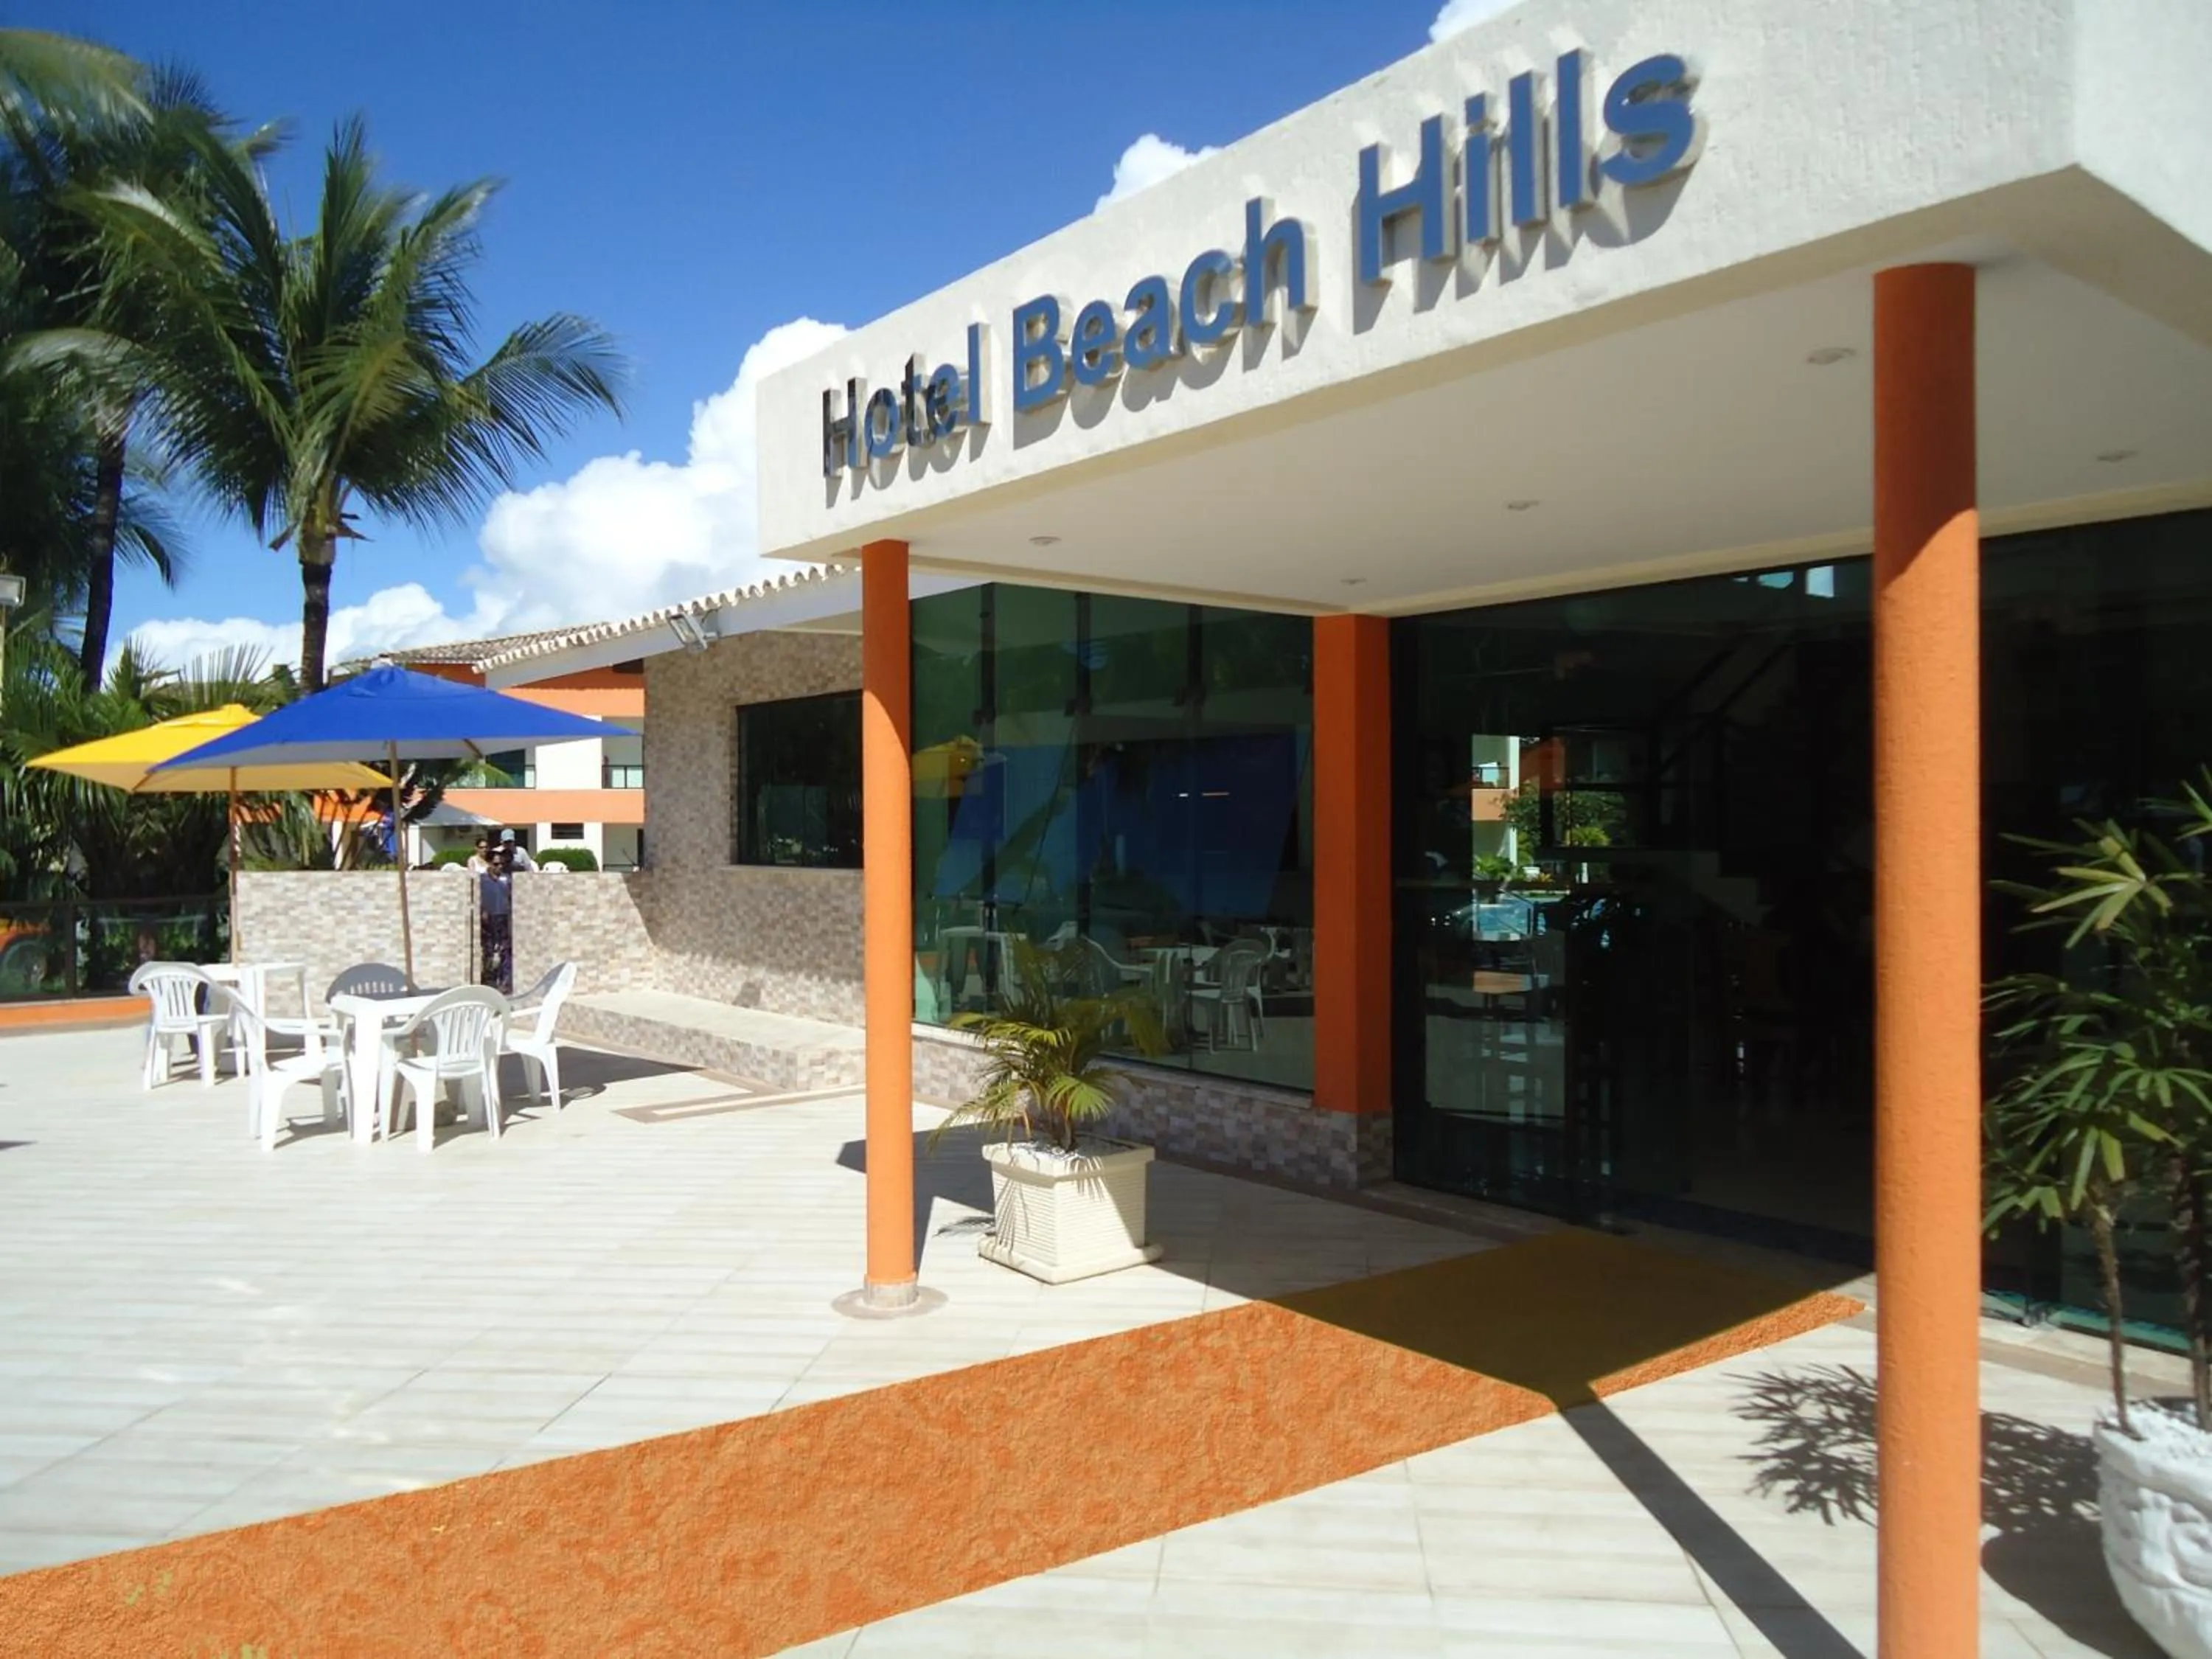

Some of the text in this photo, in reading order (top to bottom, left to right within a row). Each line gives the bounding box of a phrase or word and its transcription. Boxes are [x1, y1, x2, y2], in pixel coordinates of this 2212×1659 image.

[823, 49, 1697, 478] Hotel Beach Hills
